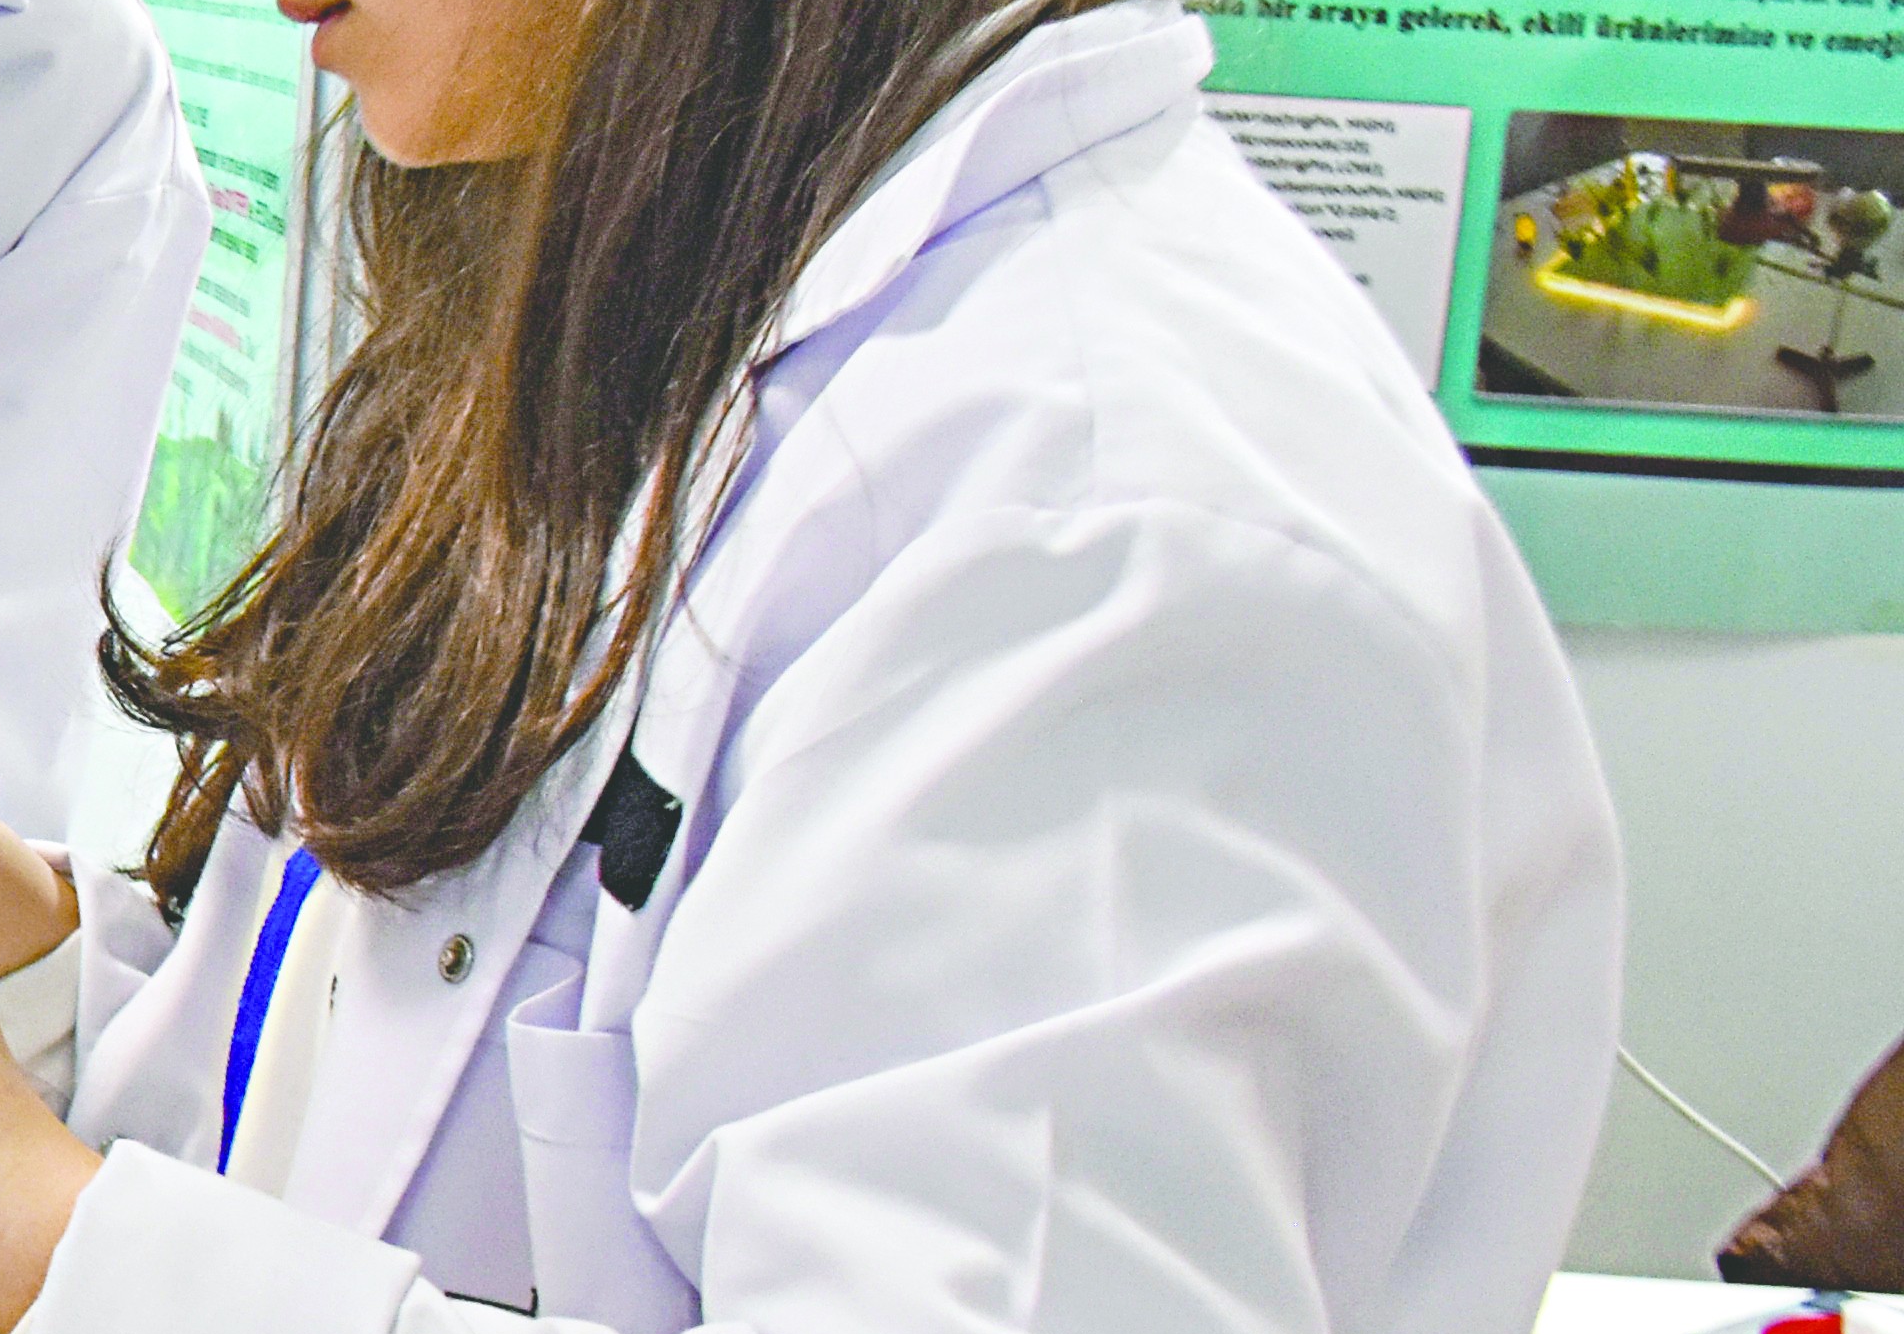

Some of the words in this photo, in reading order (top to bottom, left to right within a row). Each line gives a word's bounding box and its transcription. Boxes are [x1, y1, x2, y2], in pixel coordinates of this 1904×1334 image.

[1308, 3, 1388, 31] araya
[1523, 11, 1586, 38] ekili
[1596, 14, 1776, 49] ürünlerimize
[1786, 31, 1816, 49] ve
